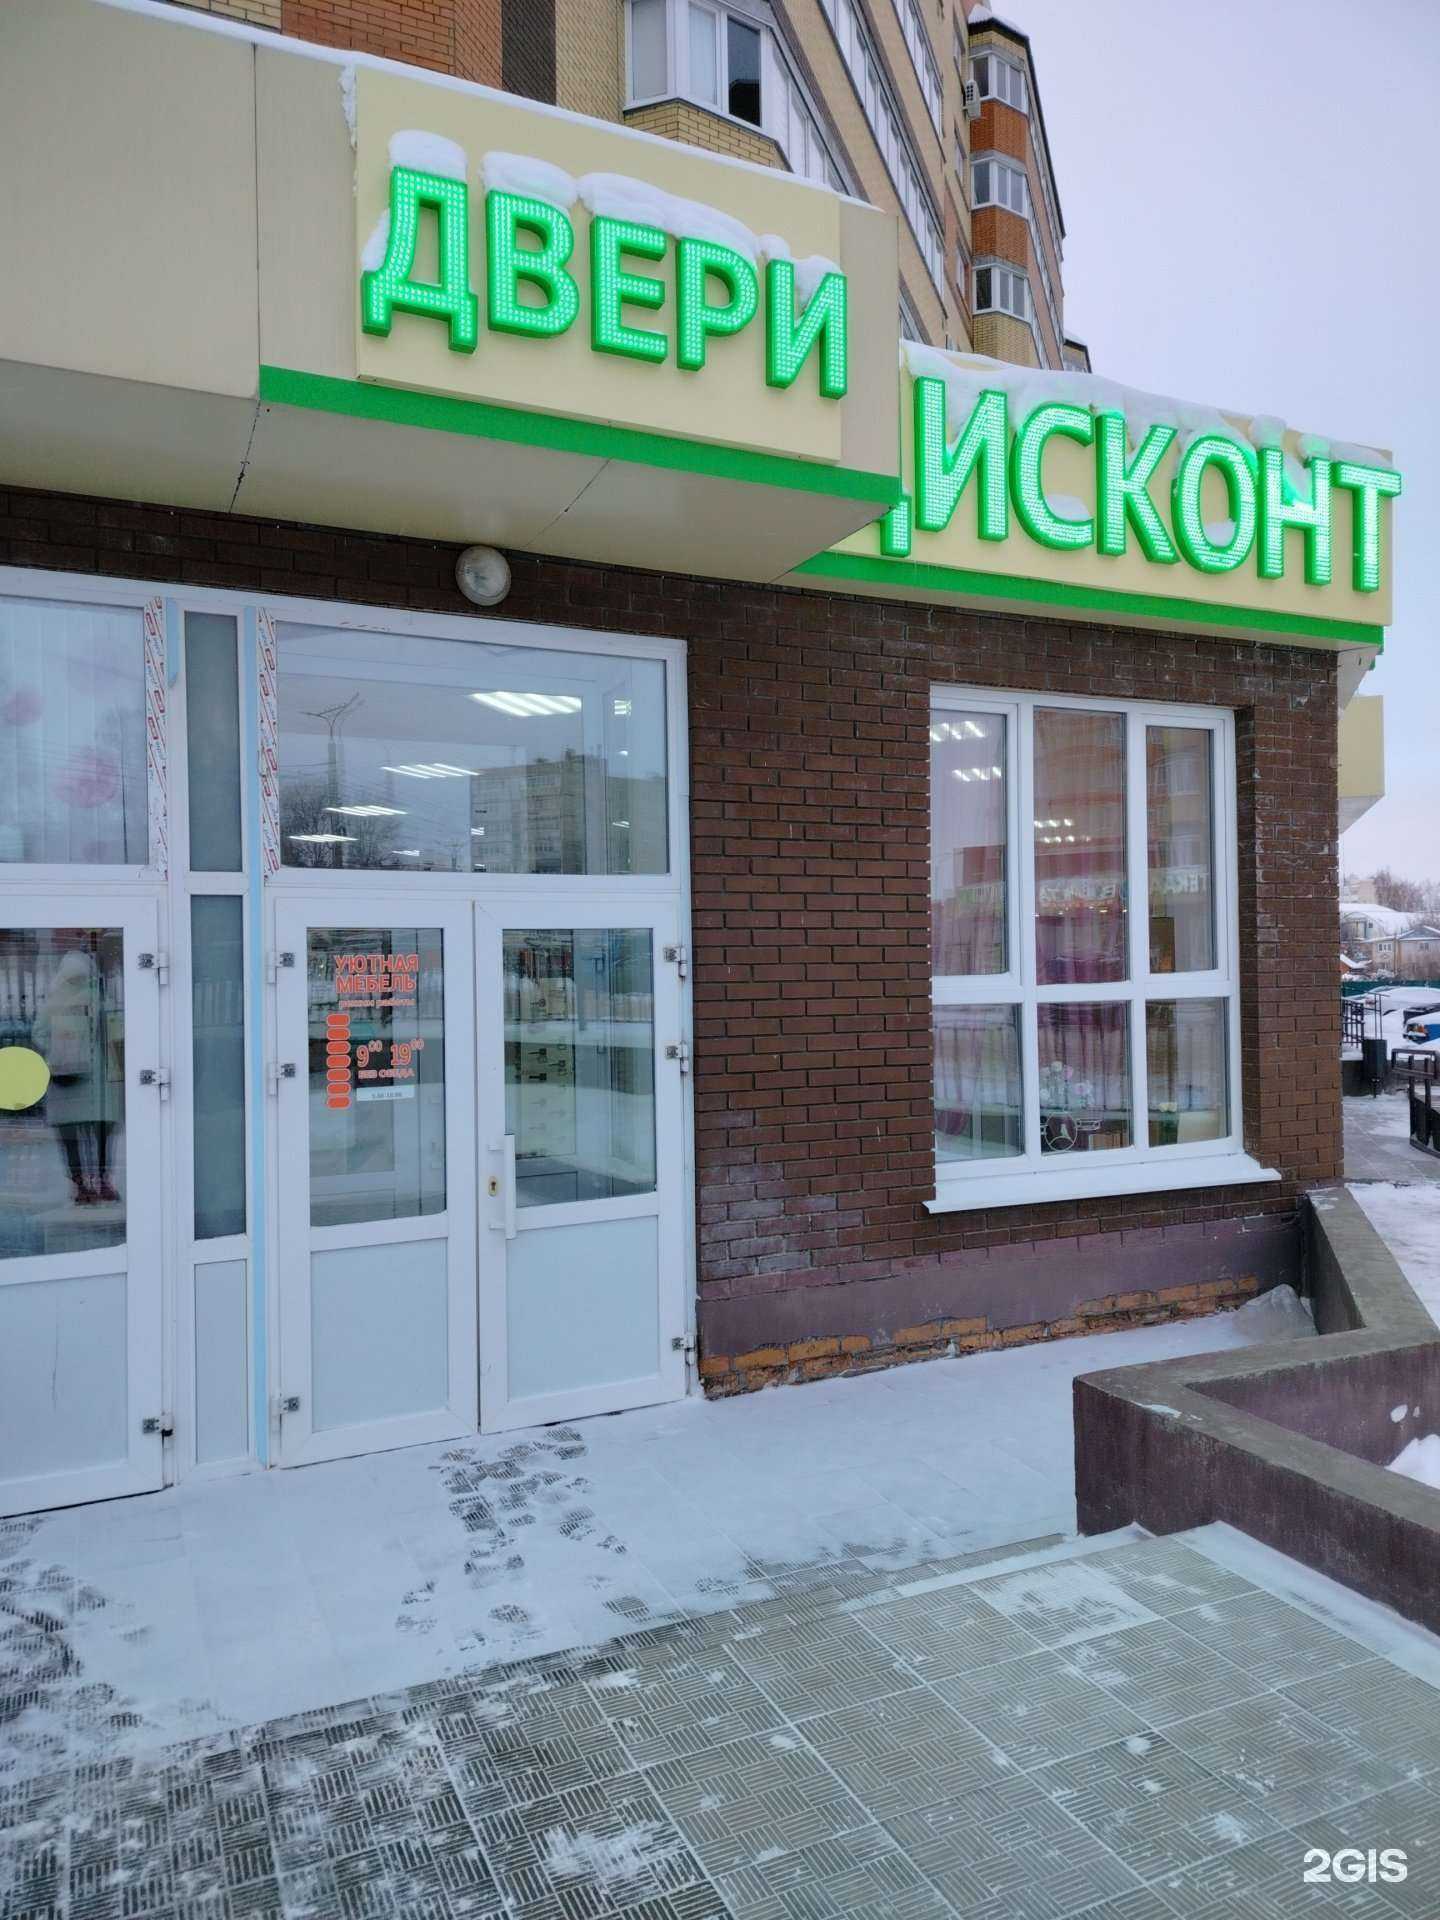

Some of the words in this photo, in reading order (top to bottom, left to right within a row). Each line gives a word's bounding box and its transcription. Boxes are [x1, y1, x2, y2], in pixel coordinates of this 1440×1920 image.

[362, 165, 847, 399] ДВЕРИ
[877, 375, 1402, 592] ИСКОНТ
[334, 953, 419, 974] УЮТНАЯ
[336, 974, 417, 993] МЕБЕЛЬ
